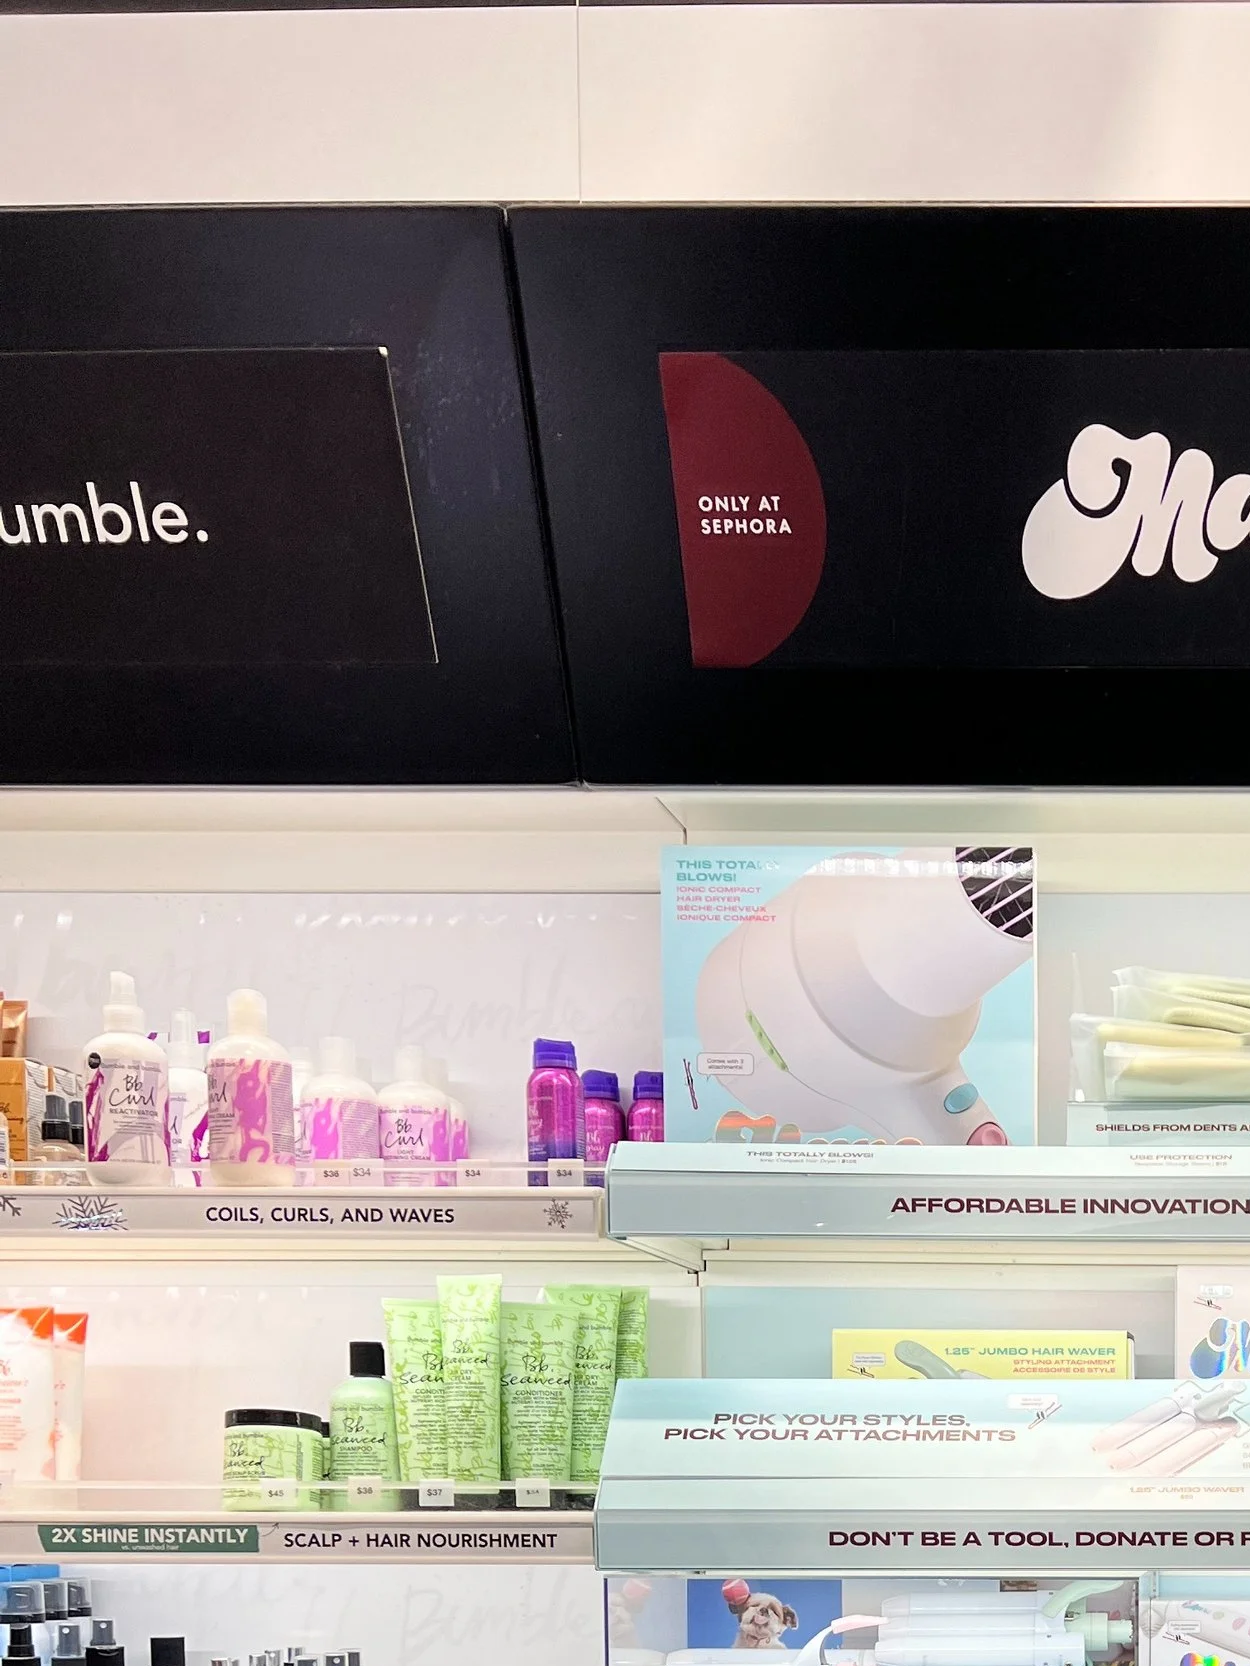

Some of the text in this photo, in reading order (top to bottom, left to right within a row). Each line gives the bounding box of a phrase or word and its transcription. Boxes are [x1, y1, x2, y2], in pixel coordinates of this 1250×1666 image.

[698, 495, 781, 512] ONLY AT
[700, 518, 793, 535] SEPHORA
[1095, 1123, 1151, 1132] SHIELDS
[1152, 1123, 1191, 1132] FROM
[1193, 1123, 1238, 1132] DENTS
[464, 1168, 481, 1179] $34
[890, 1197, 1077, 1214] AFFORDABLE
[205, 1206, 455, 1225] COILS, CURLS, AND WAVES
[713, 1412, 777, 1426] PICK
[781, 1413, 858, 1426] YOUR
[663, 1427, 1016, 1442] PICK YOUR ATTACHMENTS
[426, 1488, 443, 1497] $37
[51, 1527, 249, 1544] 2X SHINE INSTANTLY
[283, 1532, 558, 1549] SCALP + HAIR NOURISHMENT
[828, 1531, 915, 1547] DON'T
[920, 1531, 957, 1547] BE
[962, 1531, 983, 1547] A
[987, 1531, 1070, 1549] TOOL,
[1075, 1531, 1189, 1547] DONATE
[1193, 1531, 1235, 1547] OR
